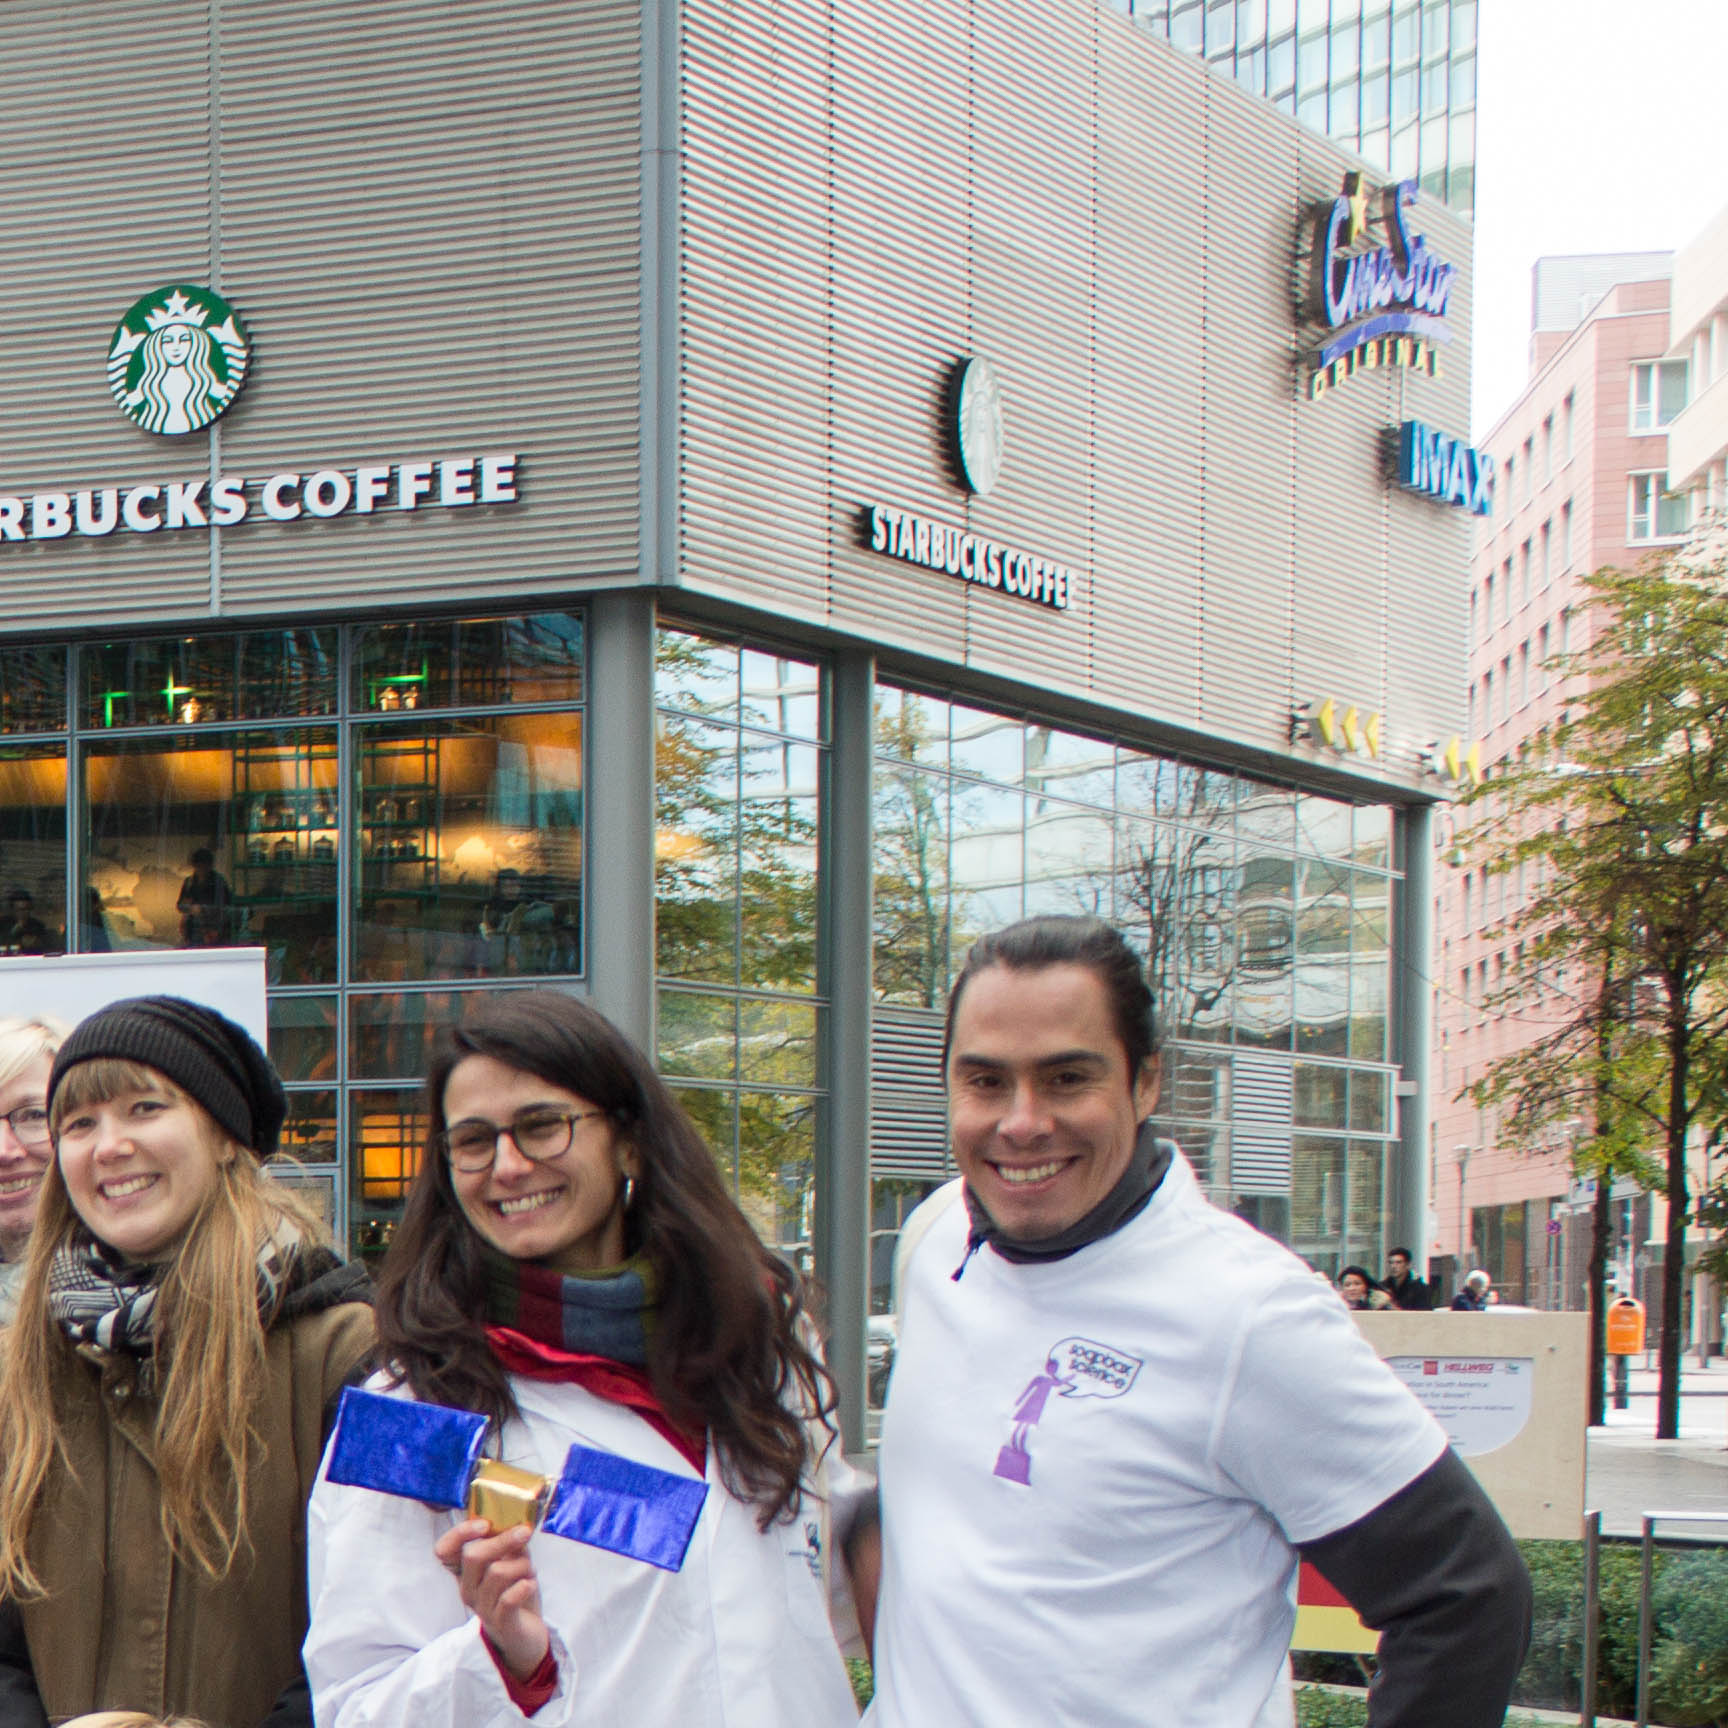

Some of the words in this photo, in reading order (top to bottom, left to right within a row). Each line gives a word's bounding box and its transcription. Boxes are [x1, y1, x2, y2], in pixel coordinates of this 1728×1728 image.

[262, 455, 519, 522] COFFEE
[1410, 420, 1494, 517] IMAX
[871, 504, 1002, 588] STARBUCKS
[1003, 548, 1076, 611] COFFEE
[1069, 1345, 1133, 1377] soapbox
[1069, 1360, 1126, 1390] science
